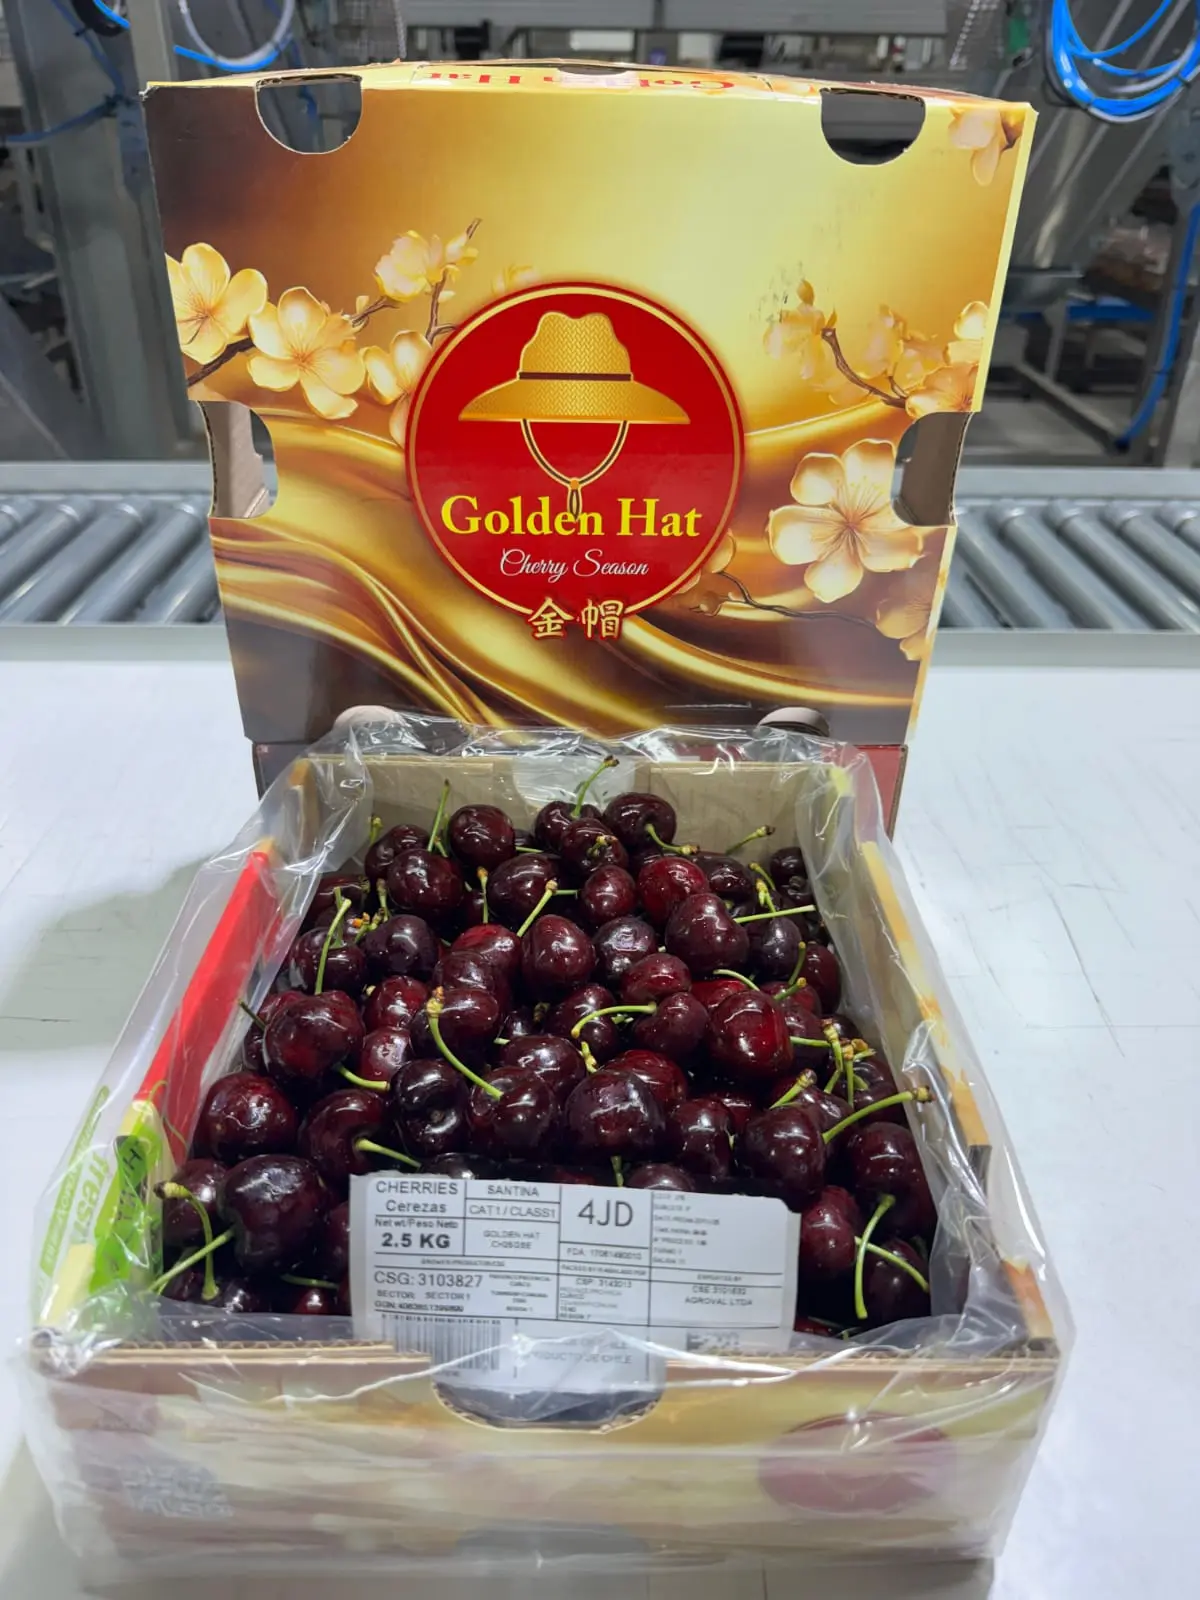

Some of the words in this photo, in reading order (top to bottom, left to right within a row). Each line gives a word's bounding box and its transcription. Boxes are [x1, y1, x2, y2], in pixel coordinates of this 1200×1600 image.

[441, 494, 605, 536] Golden
[616, 497, 703, 537] Hat
[500, 548, 568, 583] Cherry
[573, 549, 649, 577] Season
[527, 597, 625, 639] 金帽
[375, 1180, 458, 1195] CHERRIES
[487, 1185, 539, 1197] SANTINA
[385, 1199, 447, 1213] Cerezas
[578, 1199, 634, 1227] 4JD
[381, 1232, 412, 1248] 2.5
[420, 1233, 451, 1249] KG
[483, 1229, 521, 1239] GOLDEN
[523, 1232, 541, 1241] HAT
[418, 1273, 483, 1288] 3103827
